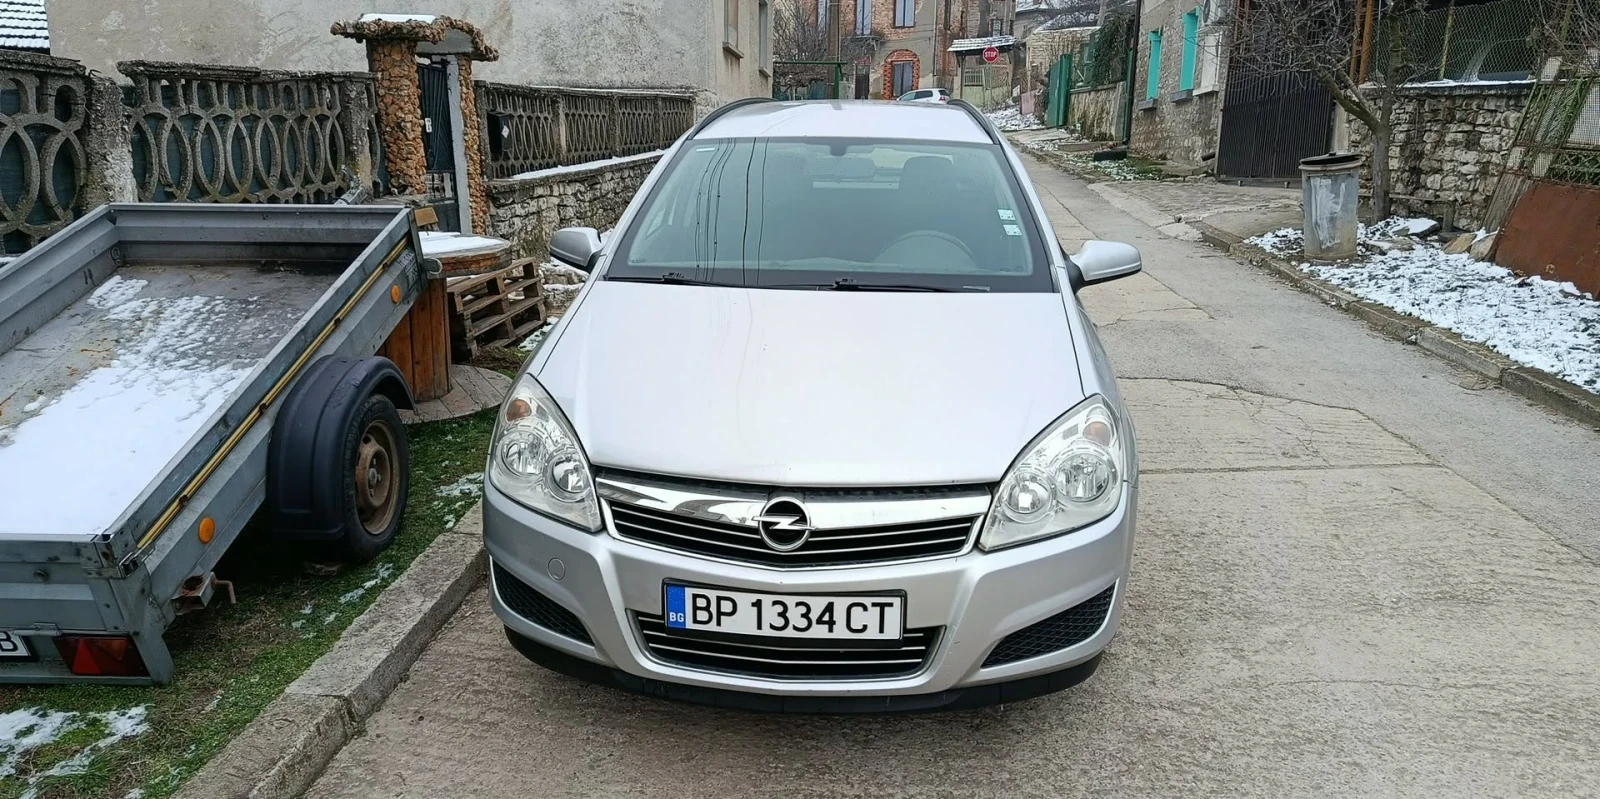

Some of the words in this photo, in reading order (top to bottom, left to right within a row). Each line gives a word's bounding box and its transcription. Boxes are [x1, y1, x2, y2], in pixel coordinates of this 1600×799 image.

[669, 611, 685, 623] BG
[691, 593, 738, 627] BP
[750, 598, 837, 634] 1334
[845, 601, 894, 634] CT
